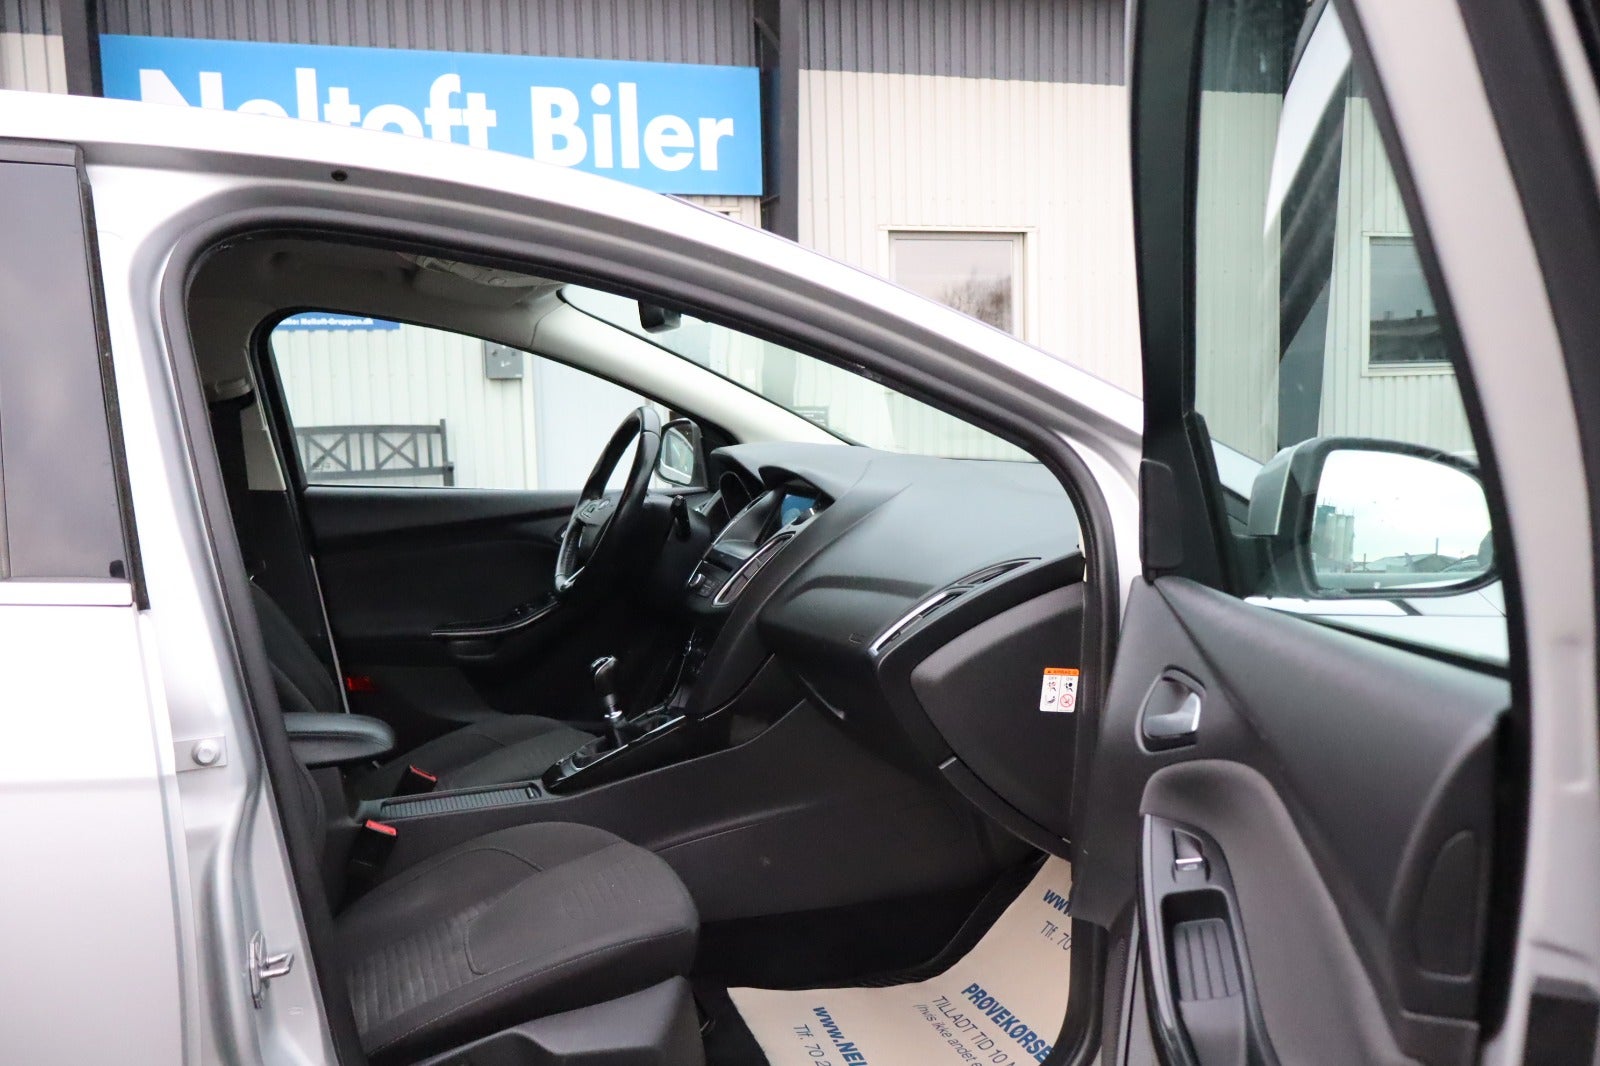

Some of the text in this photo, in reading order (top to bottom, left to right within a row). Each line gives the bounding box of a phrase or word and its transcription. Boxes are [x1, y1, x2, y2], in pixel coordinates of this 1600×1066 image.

[139, 67, 734, 171] ltoft Biler
[804, 1044, 824, 1057] 70
[932, 995, 1008, 1063] TILLADT TID 10
[932, 1020, 952, 1038] ikke
[948, 1038, 977, 1062] andet
